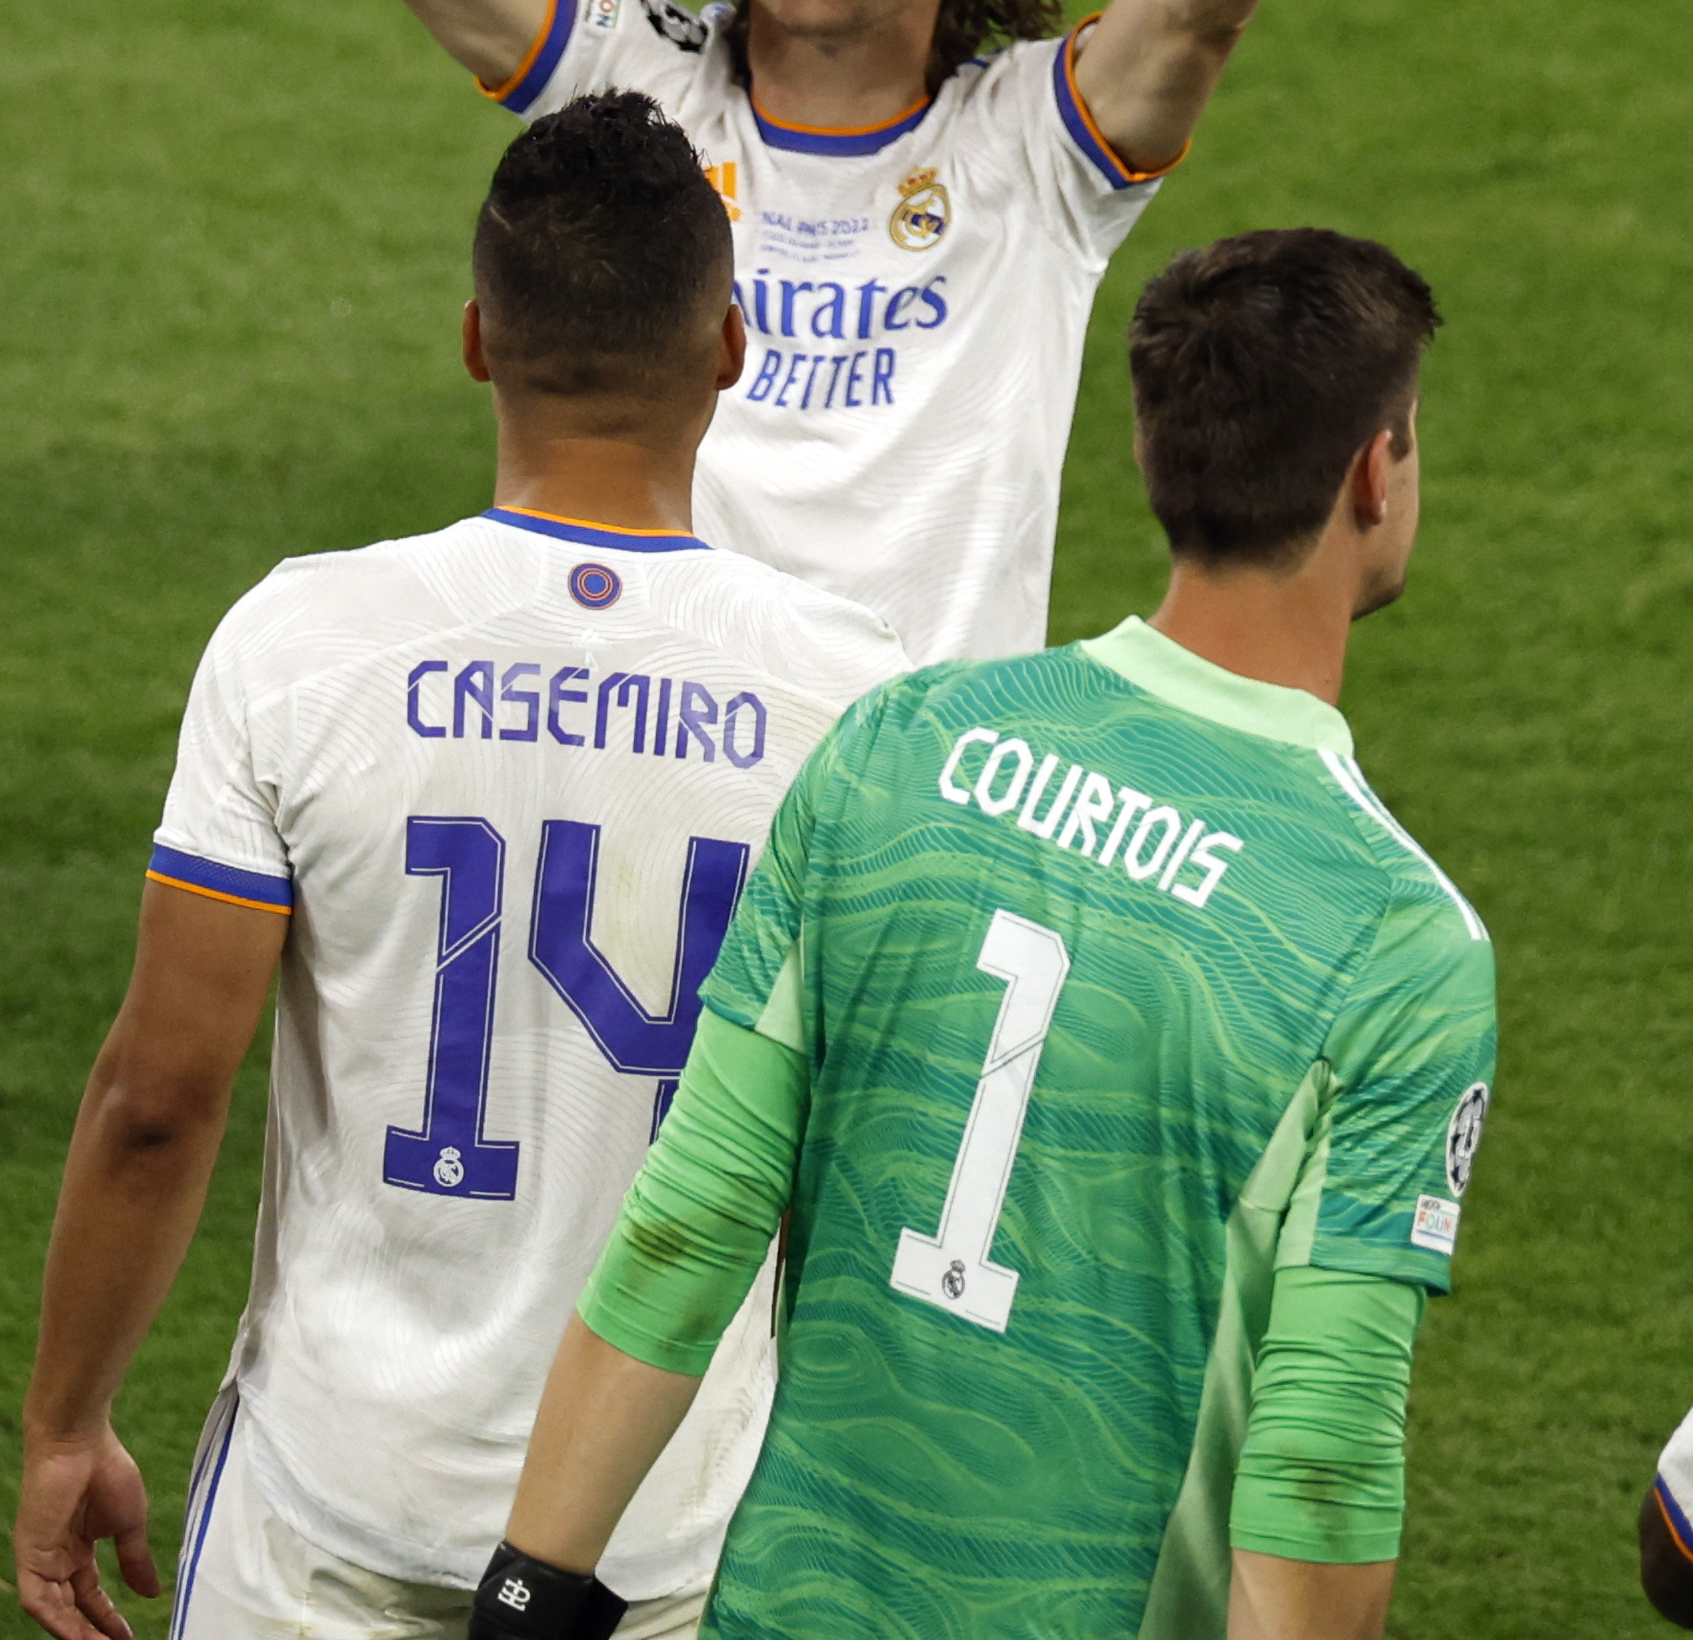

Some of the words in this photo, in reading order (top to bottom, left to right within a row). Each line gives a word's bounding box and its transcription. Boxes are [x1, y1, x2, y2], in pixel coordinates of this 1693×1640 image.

[747, 347, 895, 409] BETTER
[407, 660, 767, 769] CASEMIRO
[939, 727, 1244, 908] COURTOIS
[383, 815, 751, 1201] 14
[890, 907, 1071, 1333] 1
